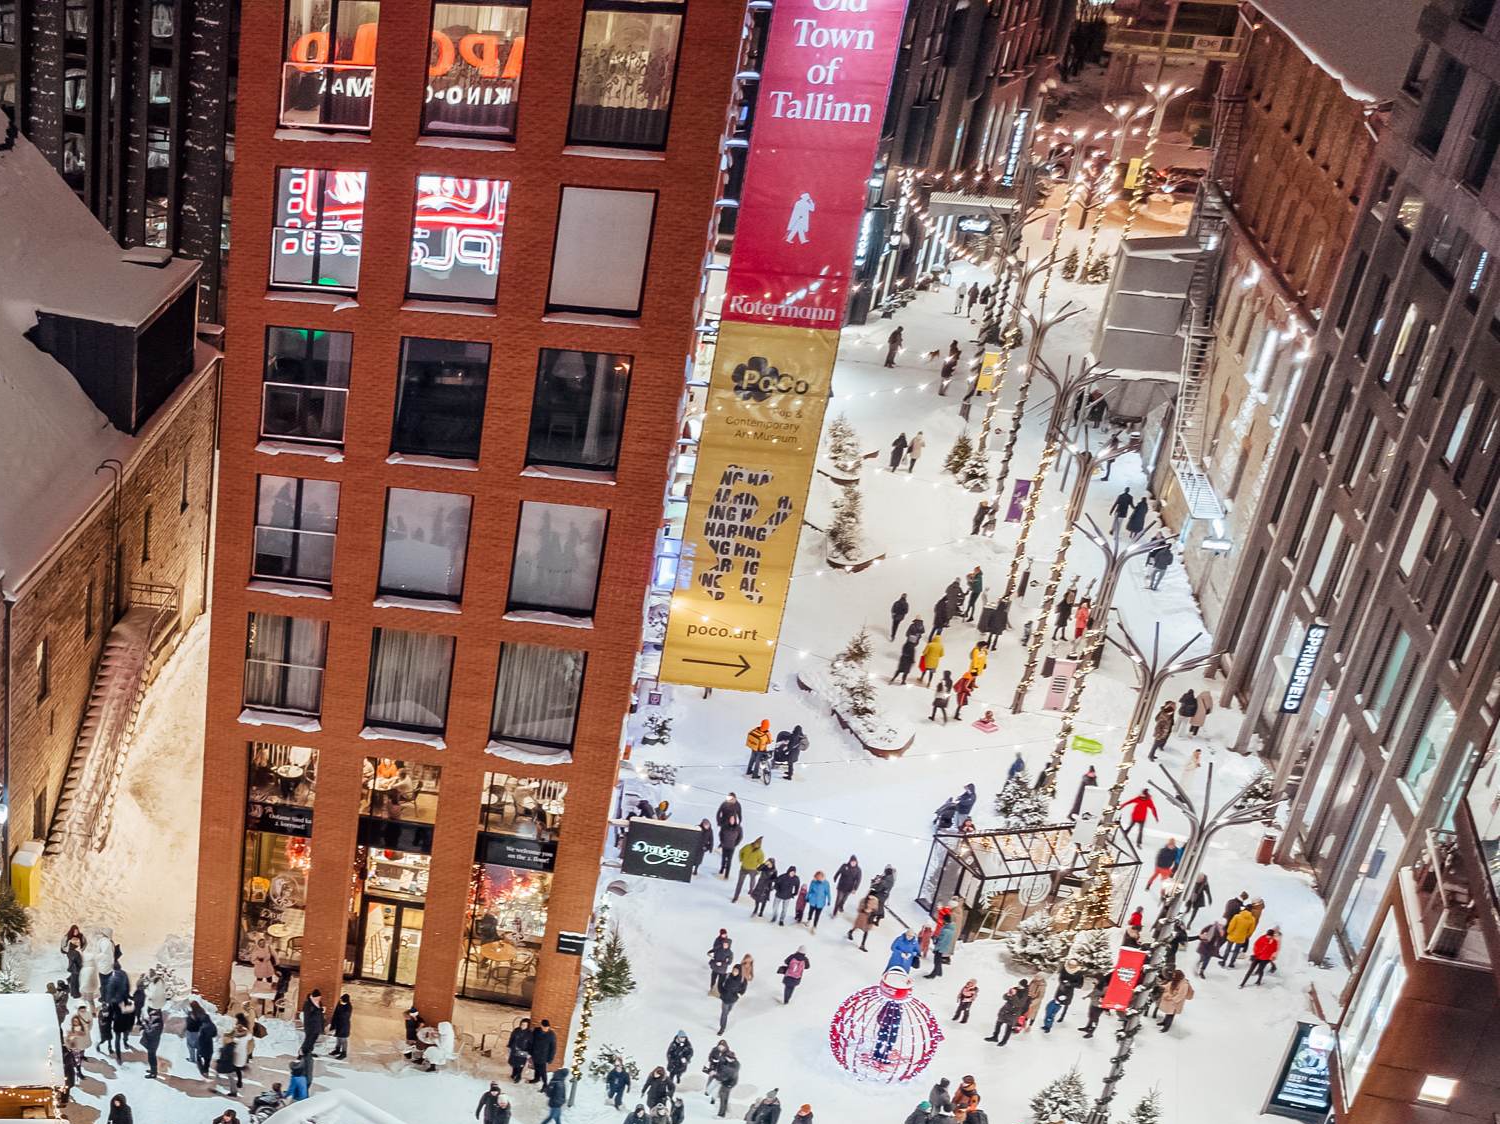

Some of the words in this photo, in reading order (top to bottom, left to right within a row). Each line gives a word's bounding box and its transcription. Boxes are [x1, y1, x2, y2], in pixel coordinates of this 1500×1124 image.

[793, 18, 875, 50] Town
[806, 57, 843, 85] of
[770, 91, 872, 123] Tallinn
[729, 295, 836, 321] Rotermann
[725, 416, 800, 433] Contemporary
[704, 522, 768, 541] HARING
[686, 623, 758, 641] poco.art
[1283, 627, 1326, 710] SPRINGFIELD
